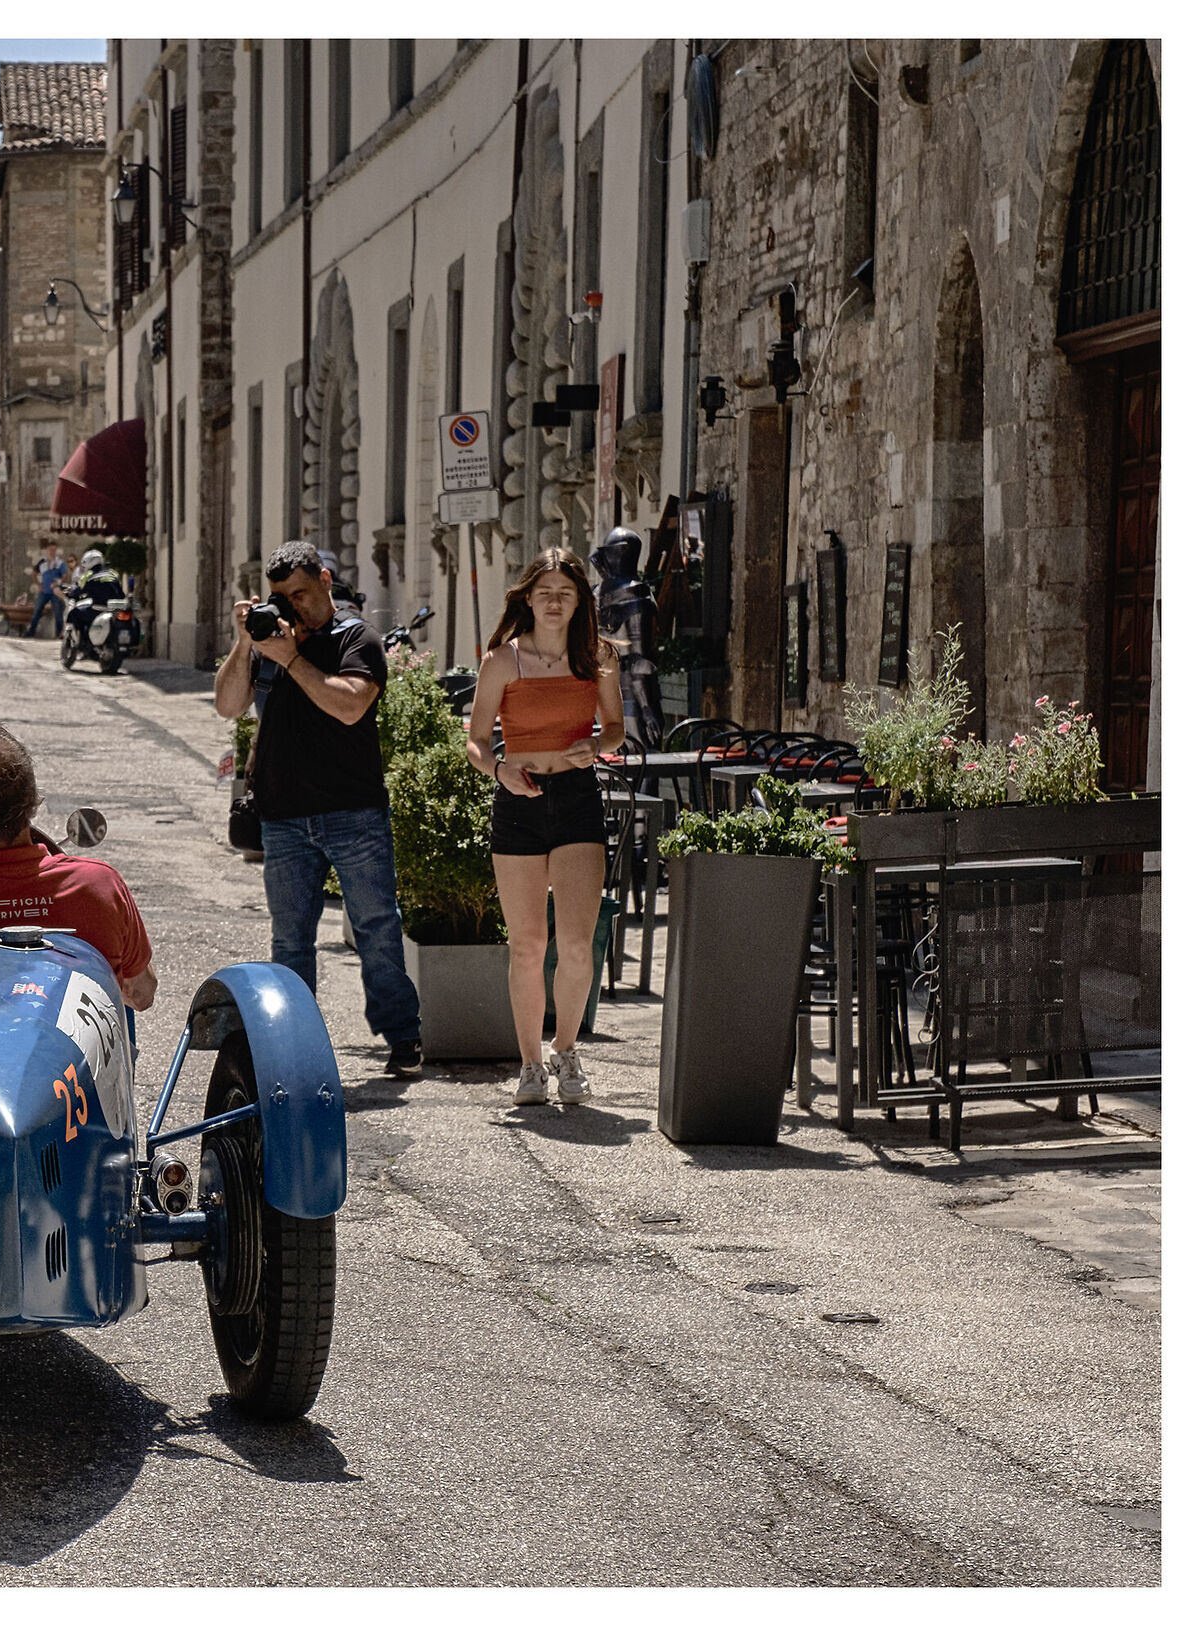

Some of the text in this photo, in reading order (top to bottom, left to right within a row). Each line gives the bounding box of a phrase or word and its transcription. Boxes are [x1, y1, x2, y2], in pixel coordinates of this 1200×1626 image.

[62, 515, 107, 529] HOTEL
[76, 992, 115, 1068] 23
[53, 1063, 88, 1143] 23
